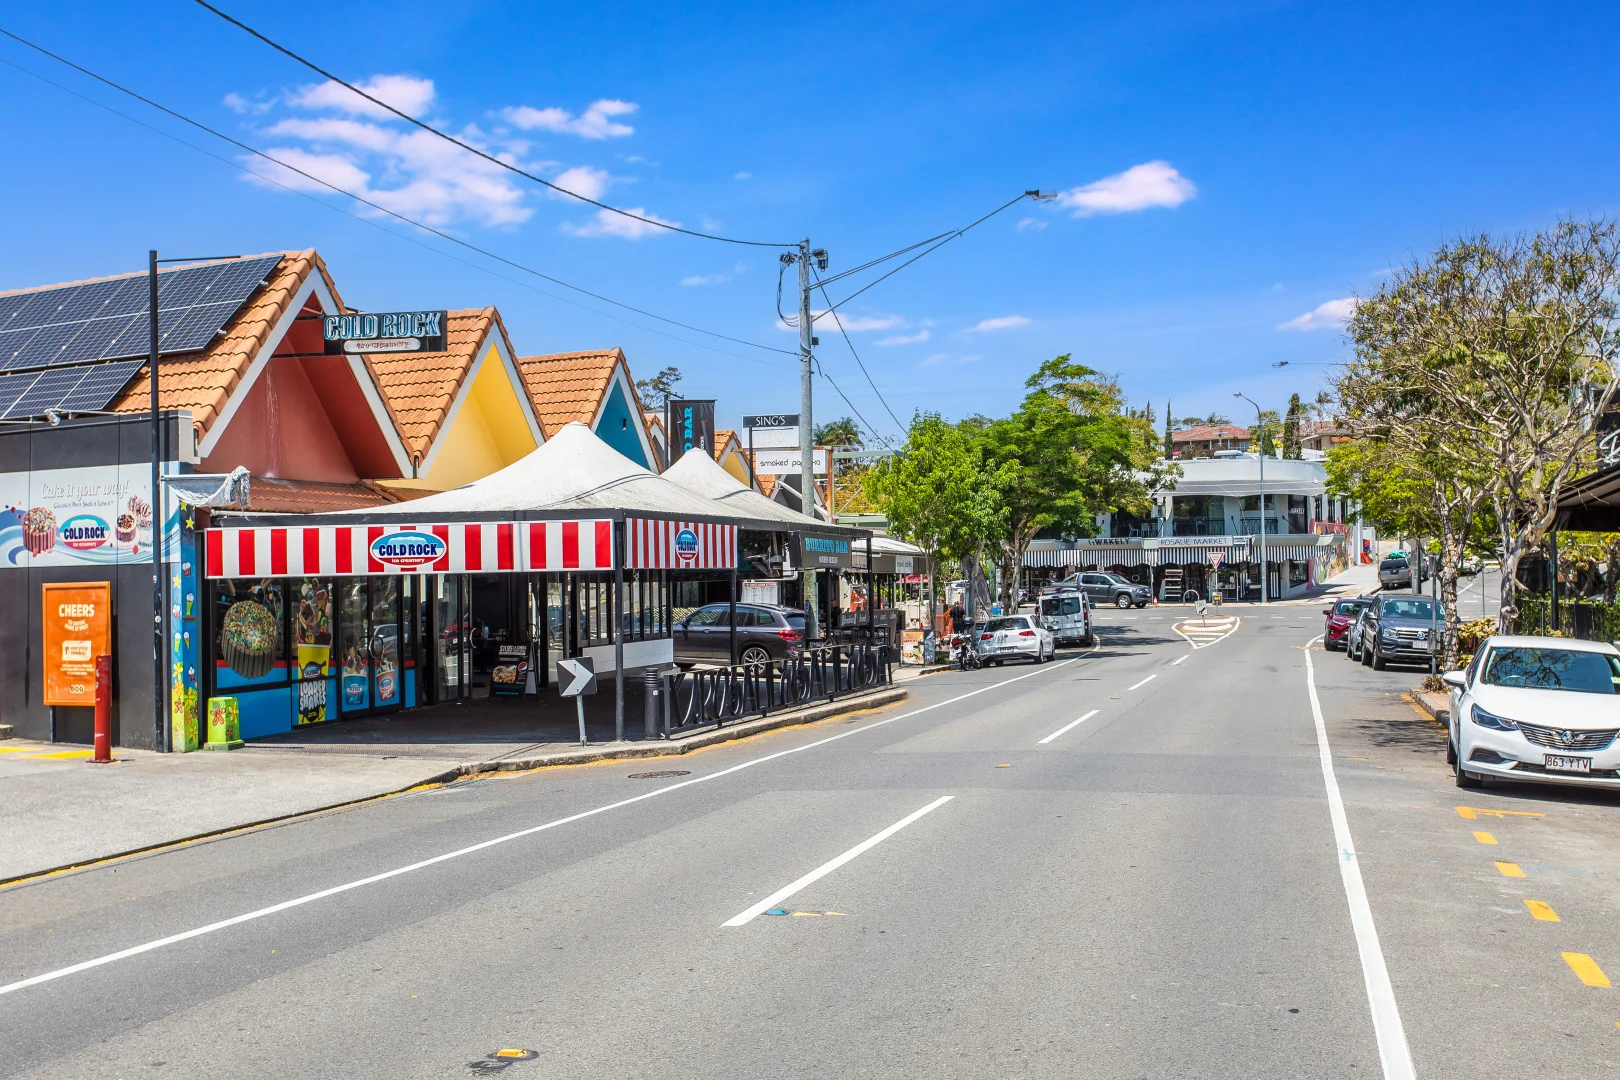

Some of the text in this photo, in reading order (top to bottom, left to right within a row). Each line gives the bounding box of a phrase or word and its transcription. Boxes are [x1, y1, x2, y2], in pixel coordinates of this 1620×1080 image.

[324, 312, 441, 340] COLD ROCK
[684, 406, 693, 439] BAR
[755, 415, 786, 426] SING'S
[760, 459, 789, 467] smoked
[41, 484, 65, 499] Cake
[76, 484, 101, 501] your
[64, 526, 105, 540] COLD ROCK
[804, 537, 849, 554] BURRITO BAR
[1160, 537, 1228, 546] ROSALIE MARKET
[378, 543, 438, 556] COLD ROCK
[58, 604, 95, 617] CHEERS
[300, 680, 326, 696] LOADED
[300, 692, 326, 711] SHAKES
[1546, 756, 1589, 769] 863 YTV
